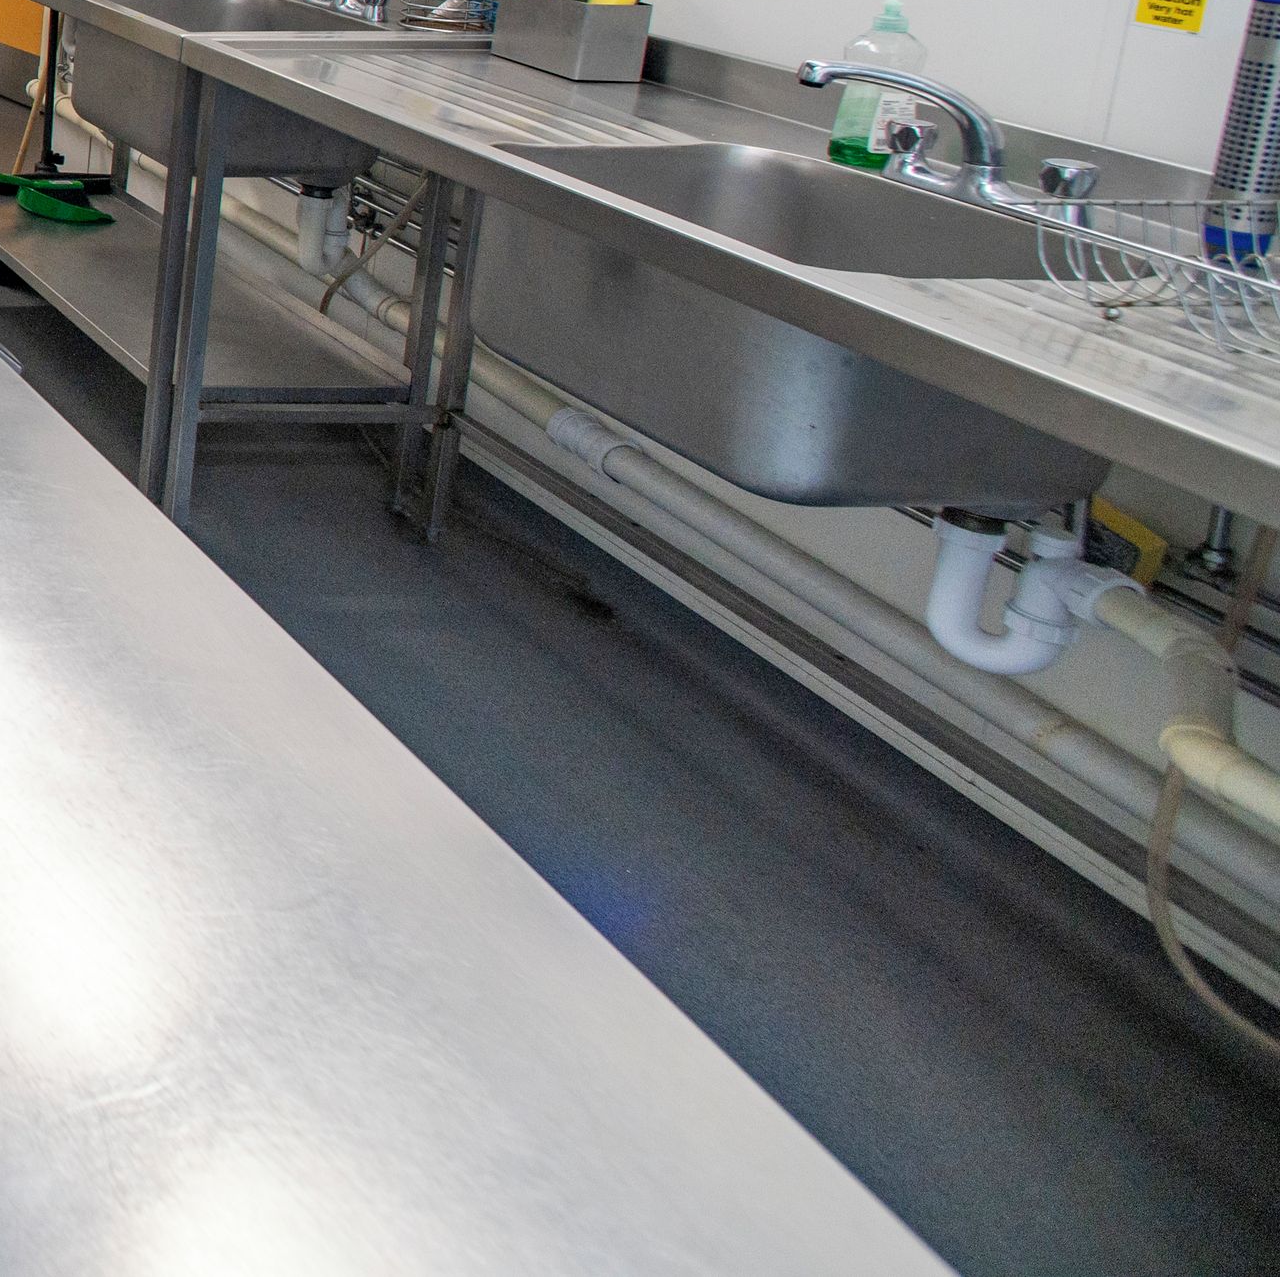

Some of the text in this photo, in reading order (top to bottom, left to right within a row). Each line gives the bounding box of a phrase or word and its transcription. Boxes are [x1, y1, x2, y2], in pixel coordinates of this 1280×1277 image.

[1148, 2, 1194, 16] Very hot
[1152, 14, 1184, 24] water
